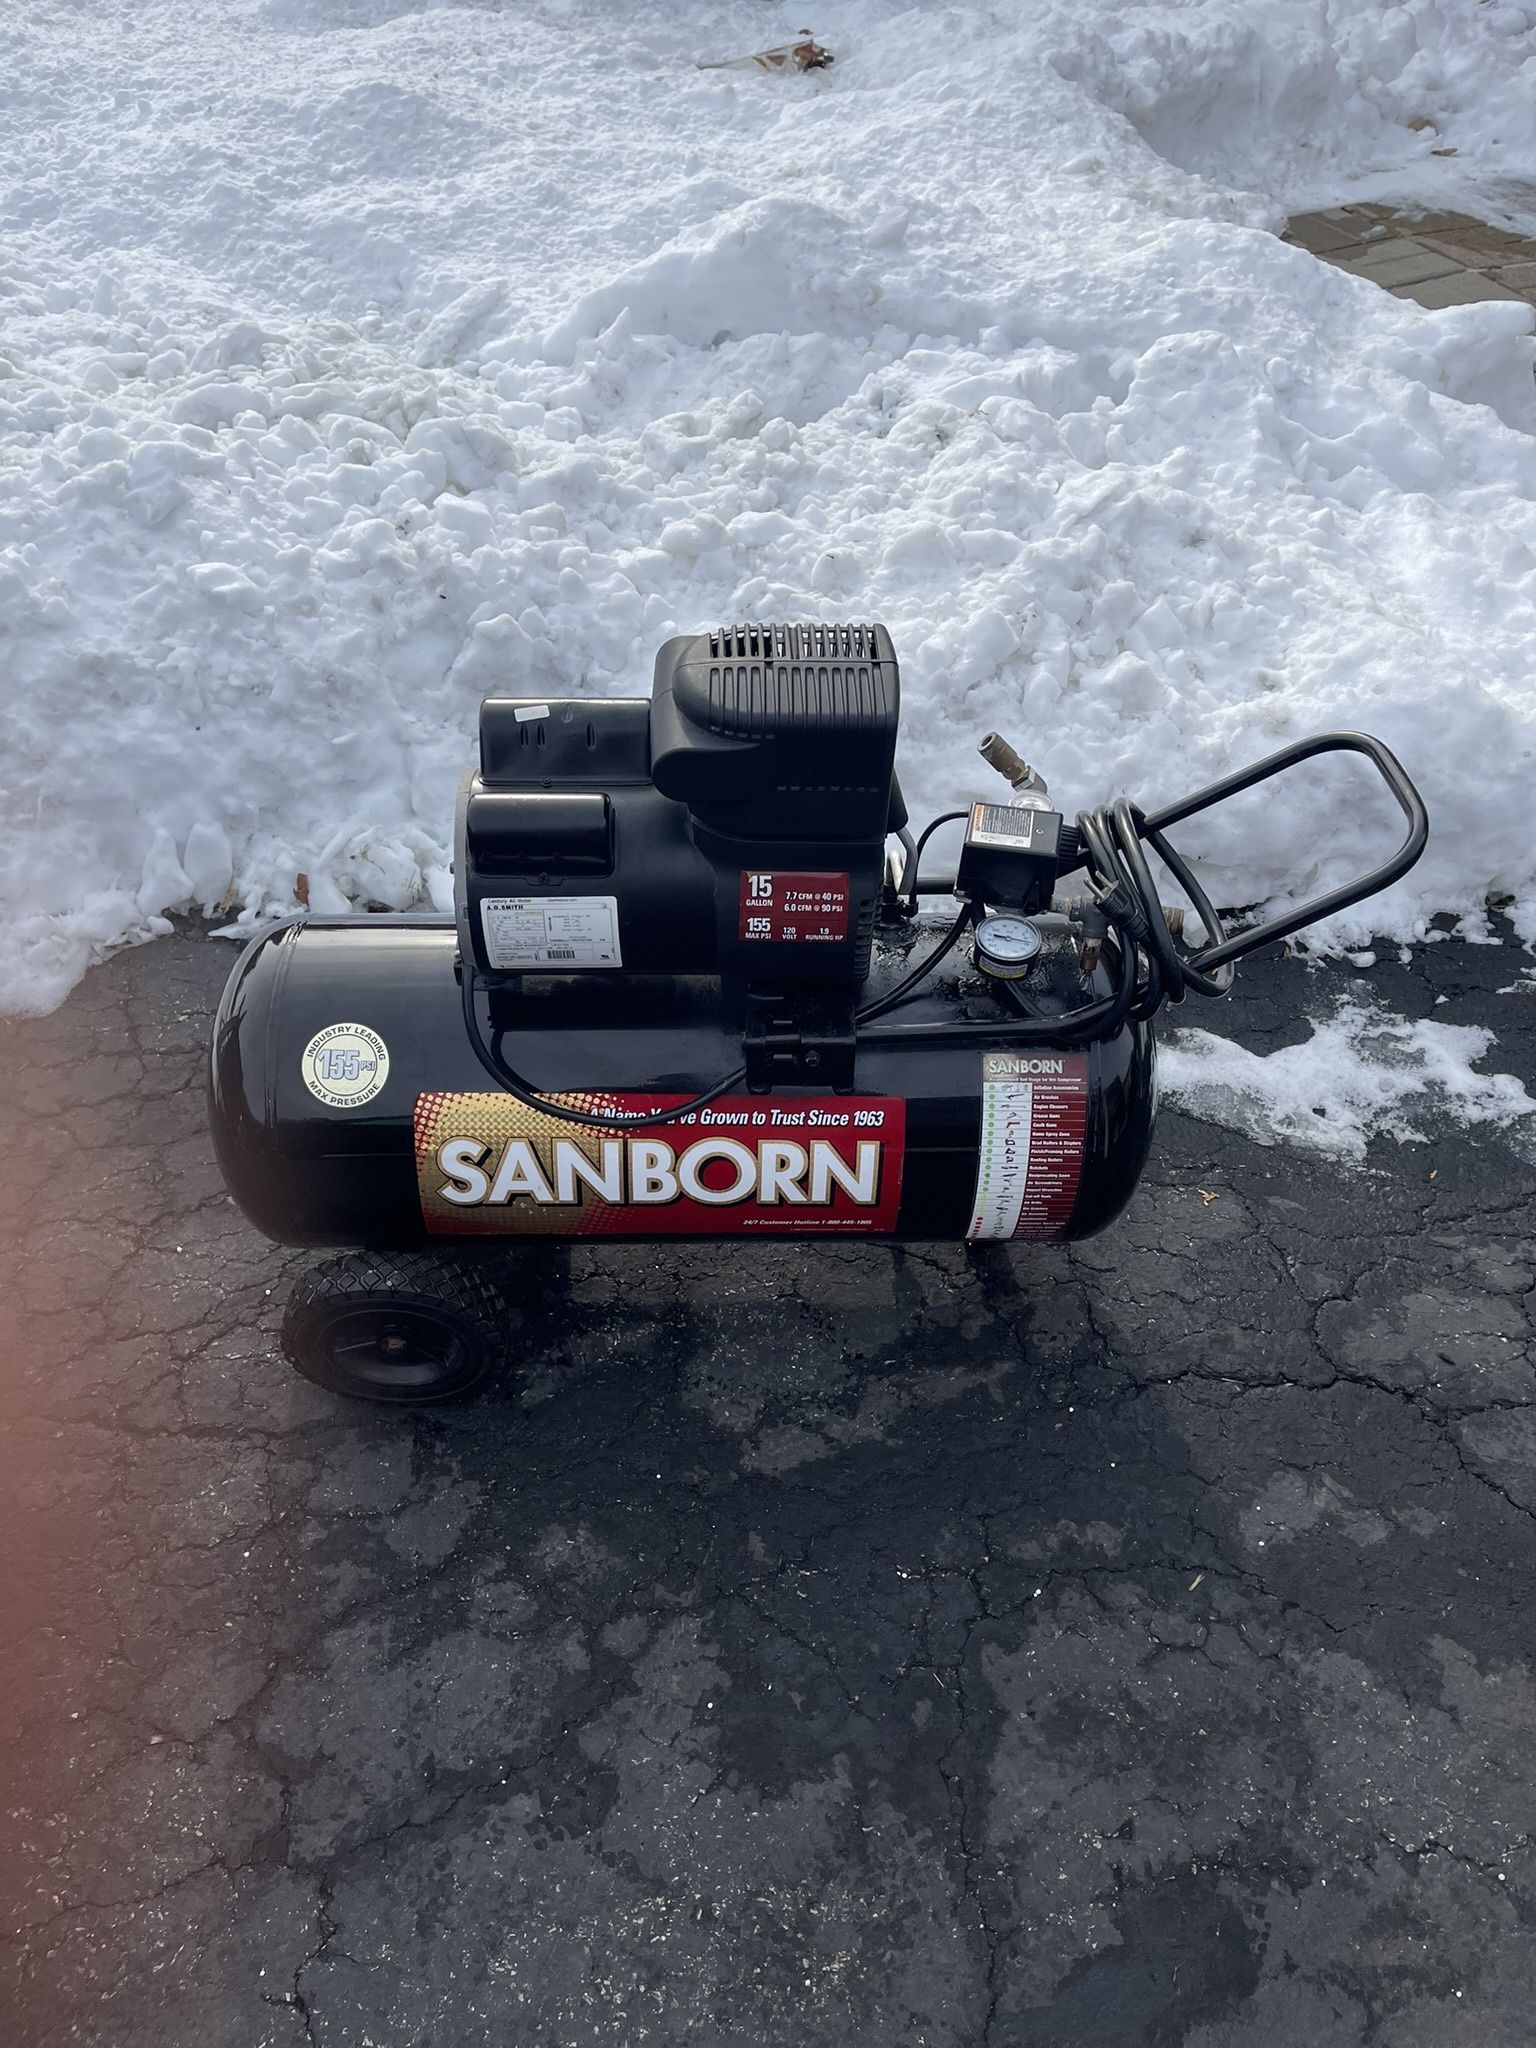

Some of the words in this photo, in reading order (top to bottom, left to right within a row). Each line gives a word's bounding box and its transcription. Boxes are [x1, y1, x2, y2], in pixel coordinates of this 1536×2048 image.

[748, 875, 772, 897] 15
[786, 892, 797, 900] 7.7
[822, 892, 832, 900] 40
[747, 918, 771, 932] 155
[307, 1026, 351, 1058] INDUSTRY
[354, 1027, 386, 1060] LEADING
[318, 1049, 360, 1080] 155
[360, 1060, 376, 1072] PSI
[989, 1059, 1064, 1074] SANBORN
[309, 1080, 328, 1100] MAX
[330, 1083, 380, 1106] PRESSURE
[700, 1108, 748, 1125] Grown
[752, 1110, 766, 1125] to
[770, 1109, 806, 1126] Trust
[808, 1110, 848, 1126] Since
[853, 1110, 884, 1126] 1963
[436, 1136, 880, 1206] SANBORN
